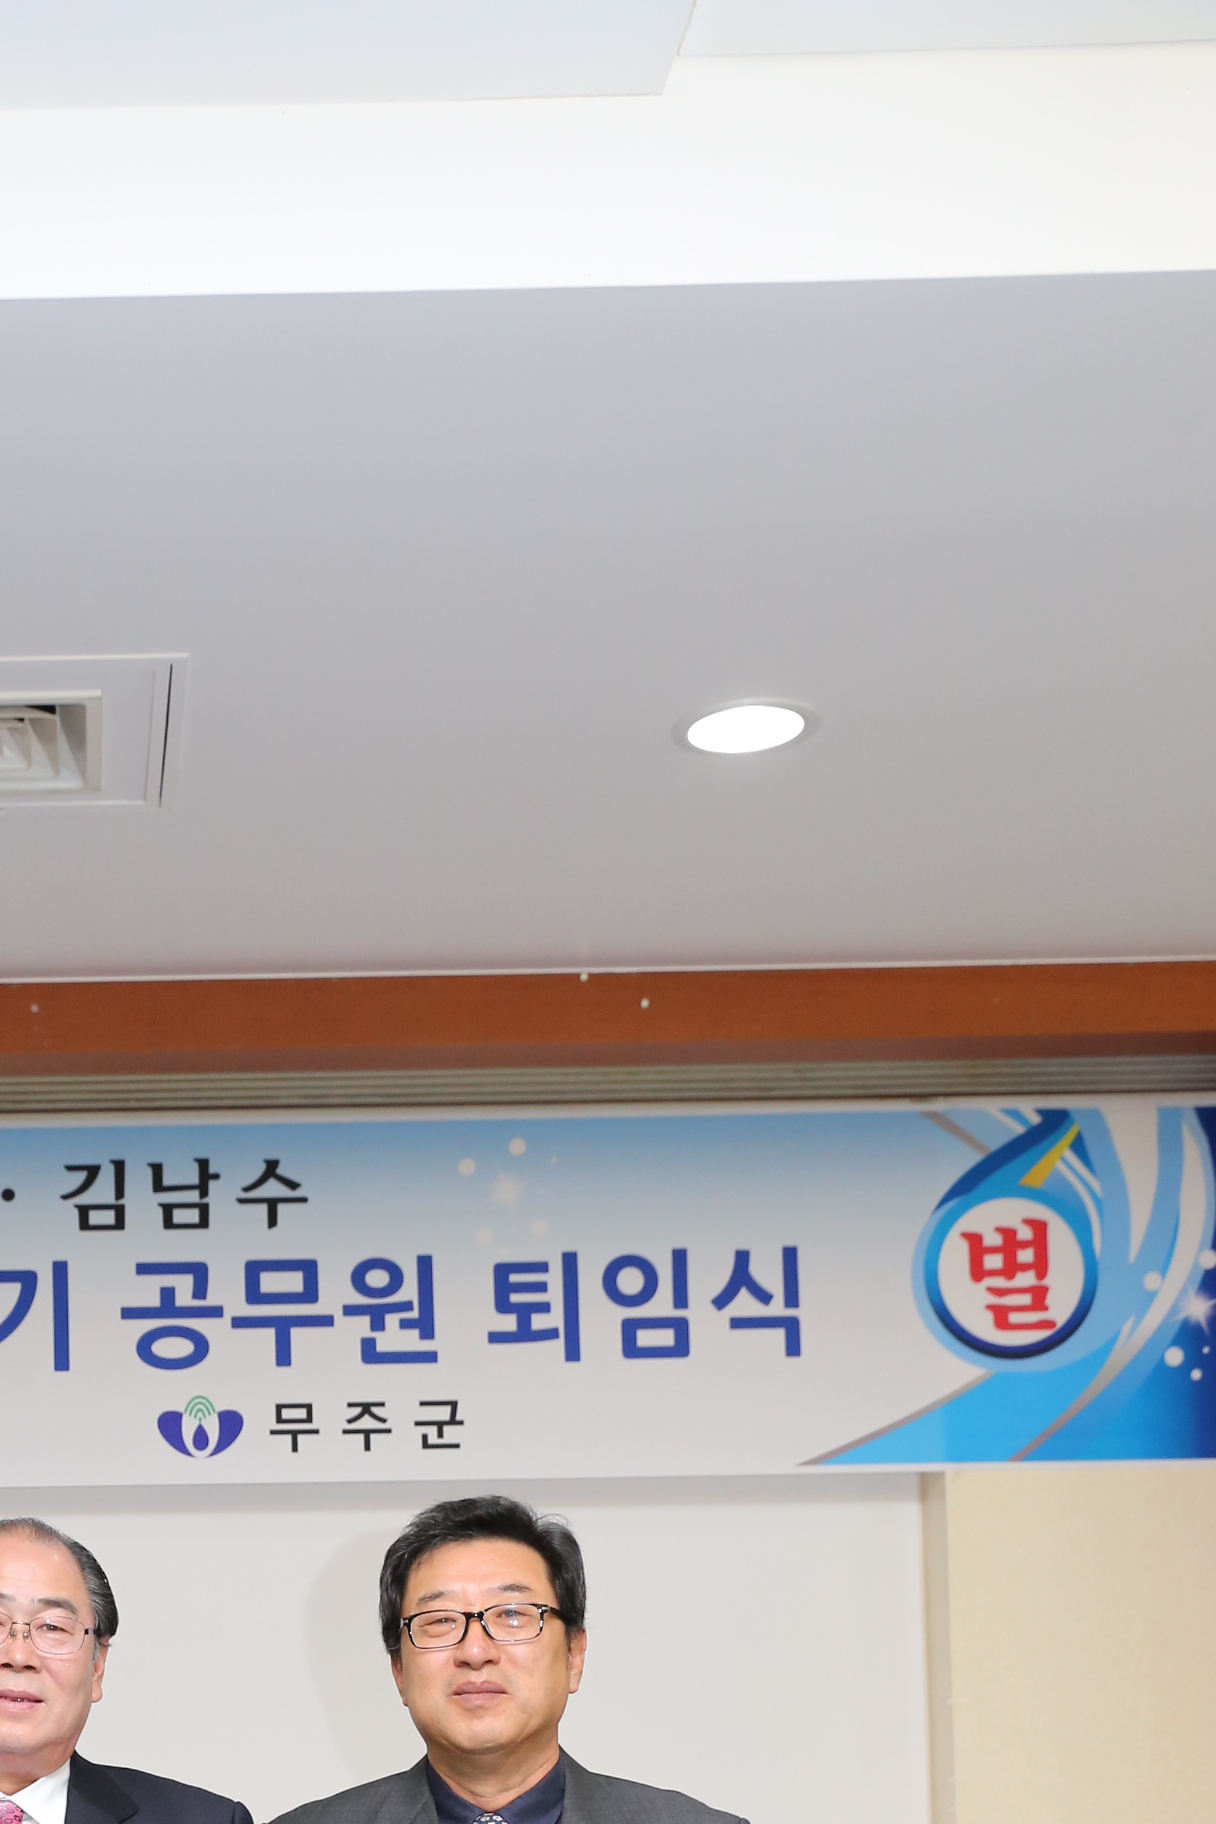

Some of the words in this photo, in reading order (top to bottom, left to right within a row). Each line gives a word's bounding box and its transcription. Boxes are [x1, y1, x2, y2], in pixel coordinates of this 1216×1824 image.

[60, 1156, 309, 1232] 김남수
[121, 1254, 438, 1370] 공무원
[488, 1246, 801, 1362] 퇴임식
[960, 1218, 1057, 1332] 별
[269, 1400, 465, 1453] 무주군
